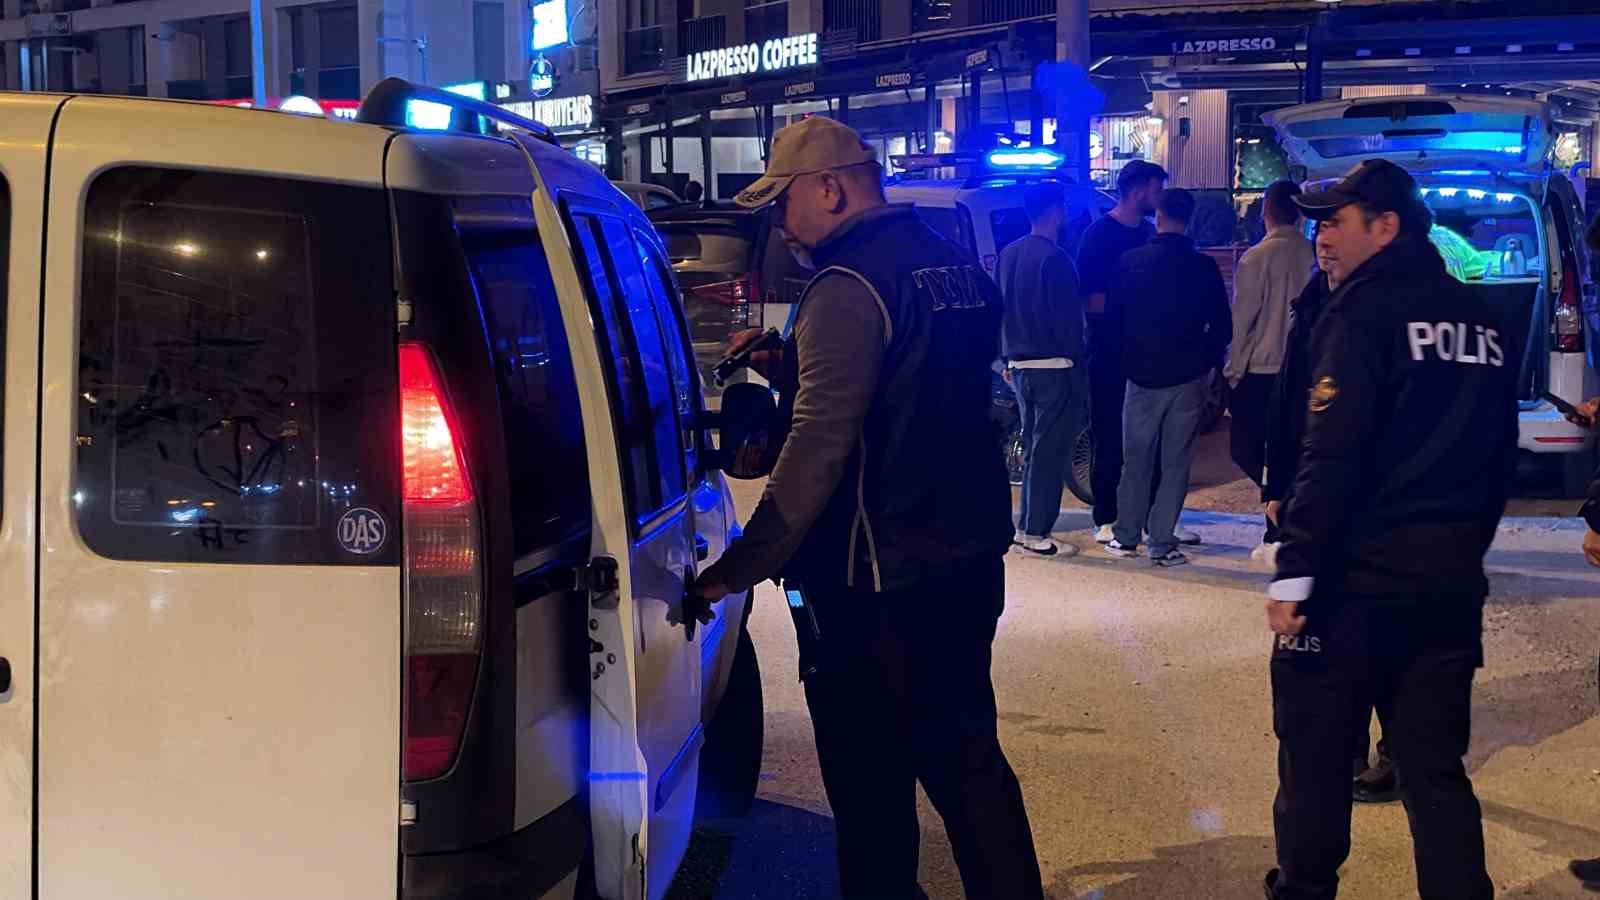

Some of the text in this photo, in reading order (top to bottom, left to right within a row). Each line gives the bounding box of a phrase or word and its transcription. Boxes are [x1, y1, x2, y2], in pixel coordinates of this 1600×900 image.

[687, 33, 817, 81] LAZPRESSO COFFEE
[1172, 37, 1276, 53] LAZPRESSO
[343, 515, 380, 547] DAS
